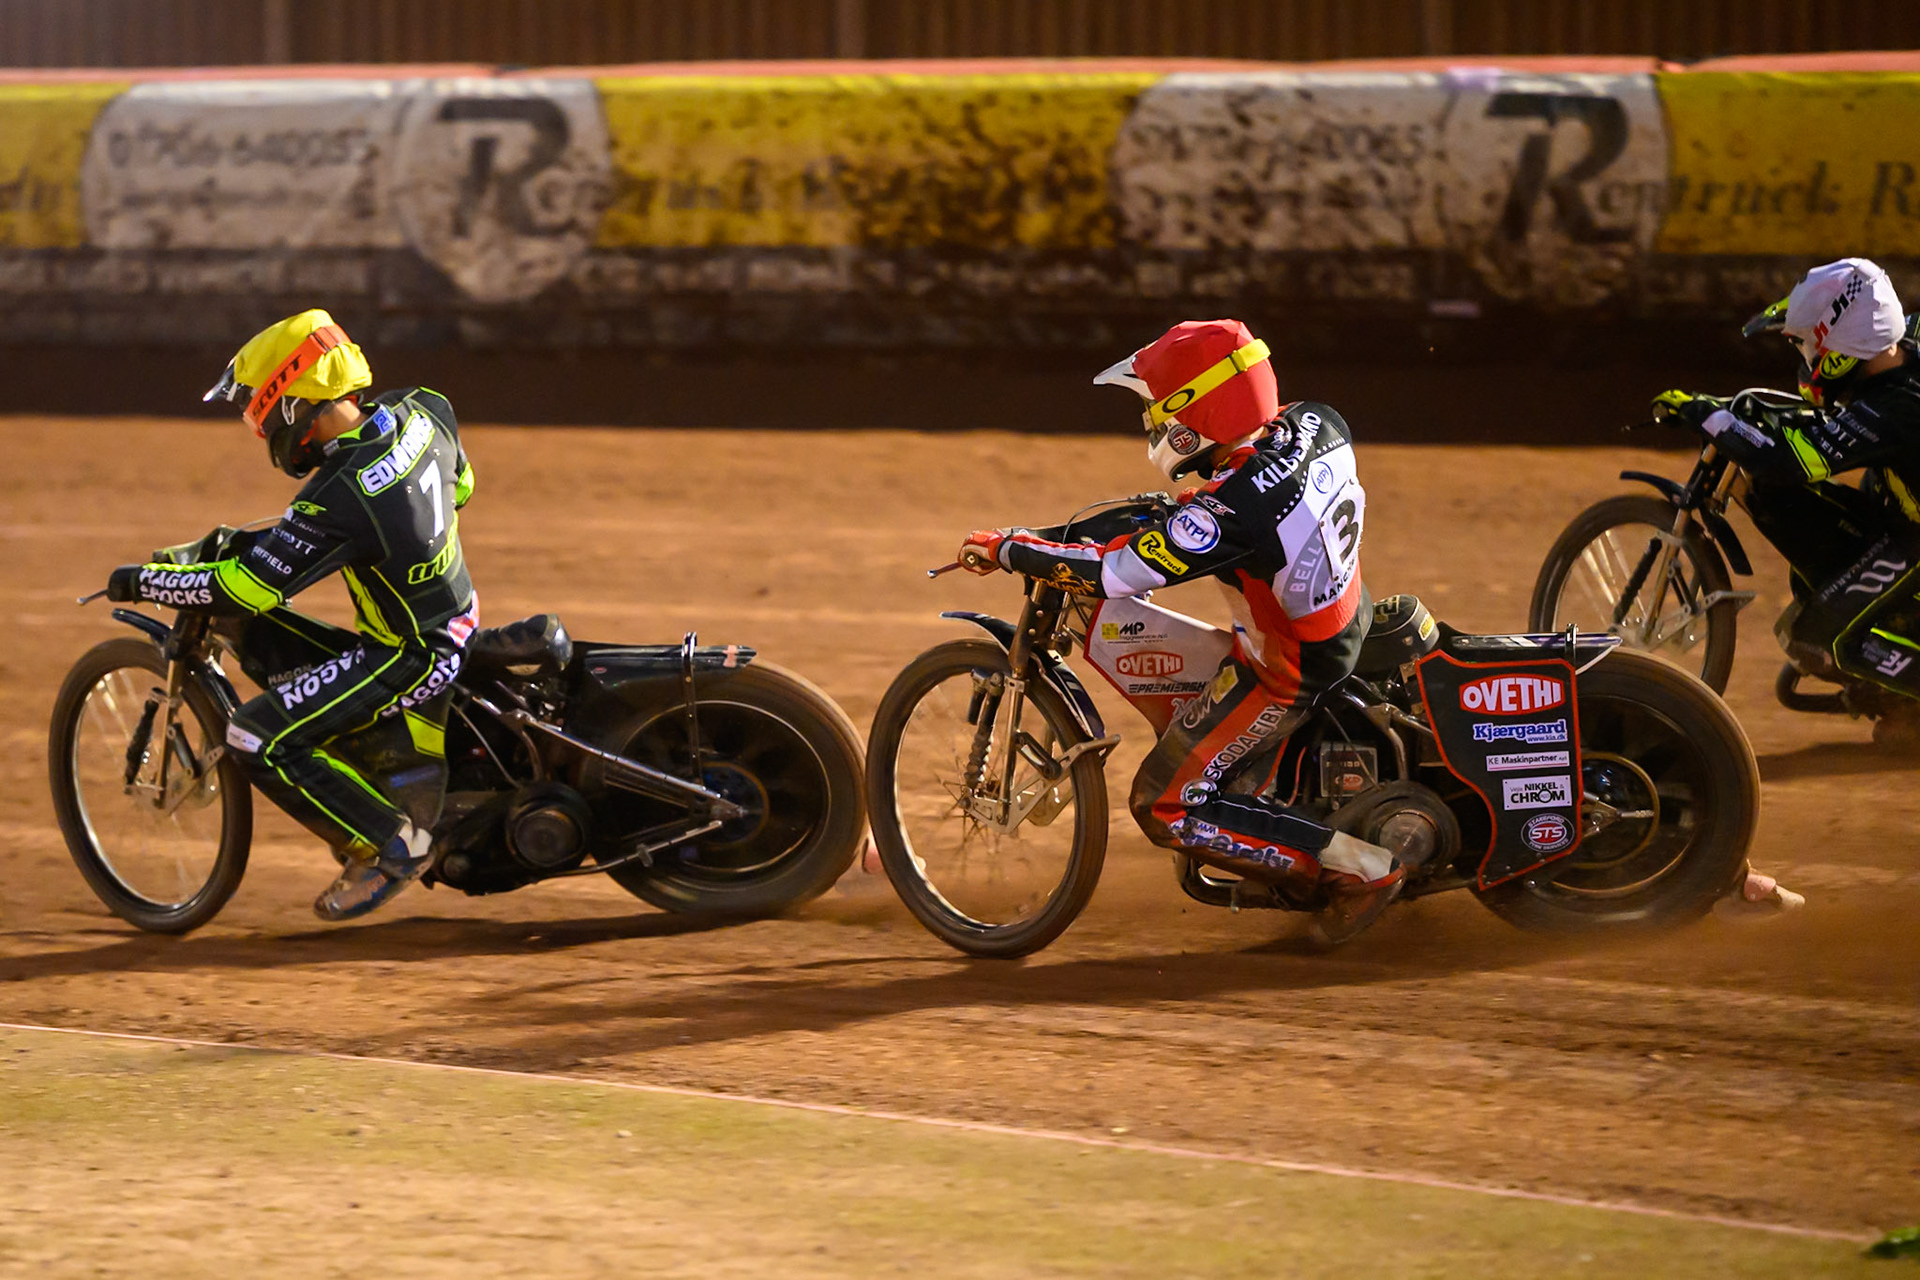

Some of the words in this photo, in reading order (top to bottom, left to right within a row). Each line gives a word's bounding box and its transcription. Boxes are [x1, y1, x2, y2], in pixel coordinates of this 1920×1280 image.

[1173, 431, 1193, 448] STS
[419, 459, 445, 537] 7
[1177, 514, 1209, 542] ATPI
[1332, 499, 1359, 564] 3
[1142, 534, 1182, 574] Rentruck
[139, 569, 213, 588] HAGON
[140, 585, 213, 604] SHOCKS
[1120, 622, 1146, 635] MP
[1118, 653, 1181, 675] OVETHI
[1463, 677, 1562, 712] OVETHI
[1474, 720, 1566, 741] Kjærgaard
[1203, 735, 1261, 781] SKODA
[1488, 757, 1499, 765] KE
[1502, 755, 1558, 765] Maskinpartner
[1510, 789, 1565, 804] CHROM
[1524, 782, 1558, 791] NIKKEL
[1531, 826, 1563, 839] STS
